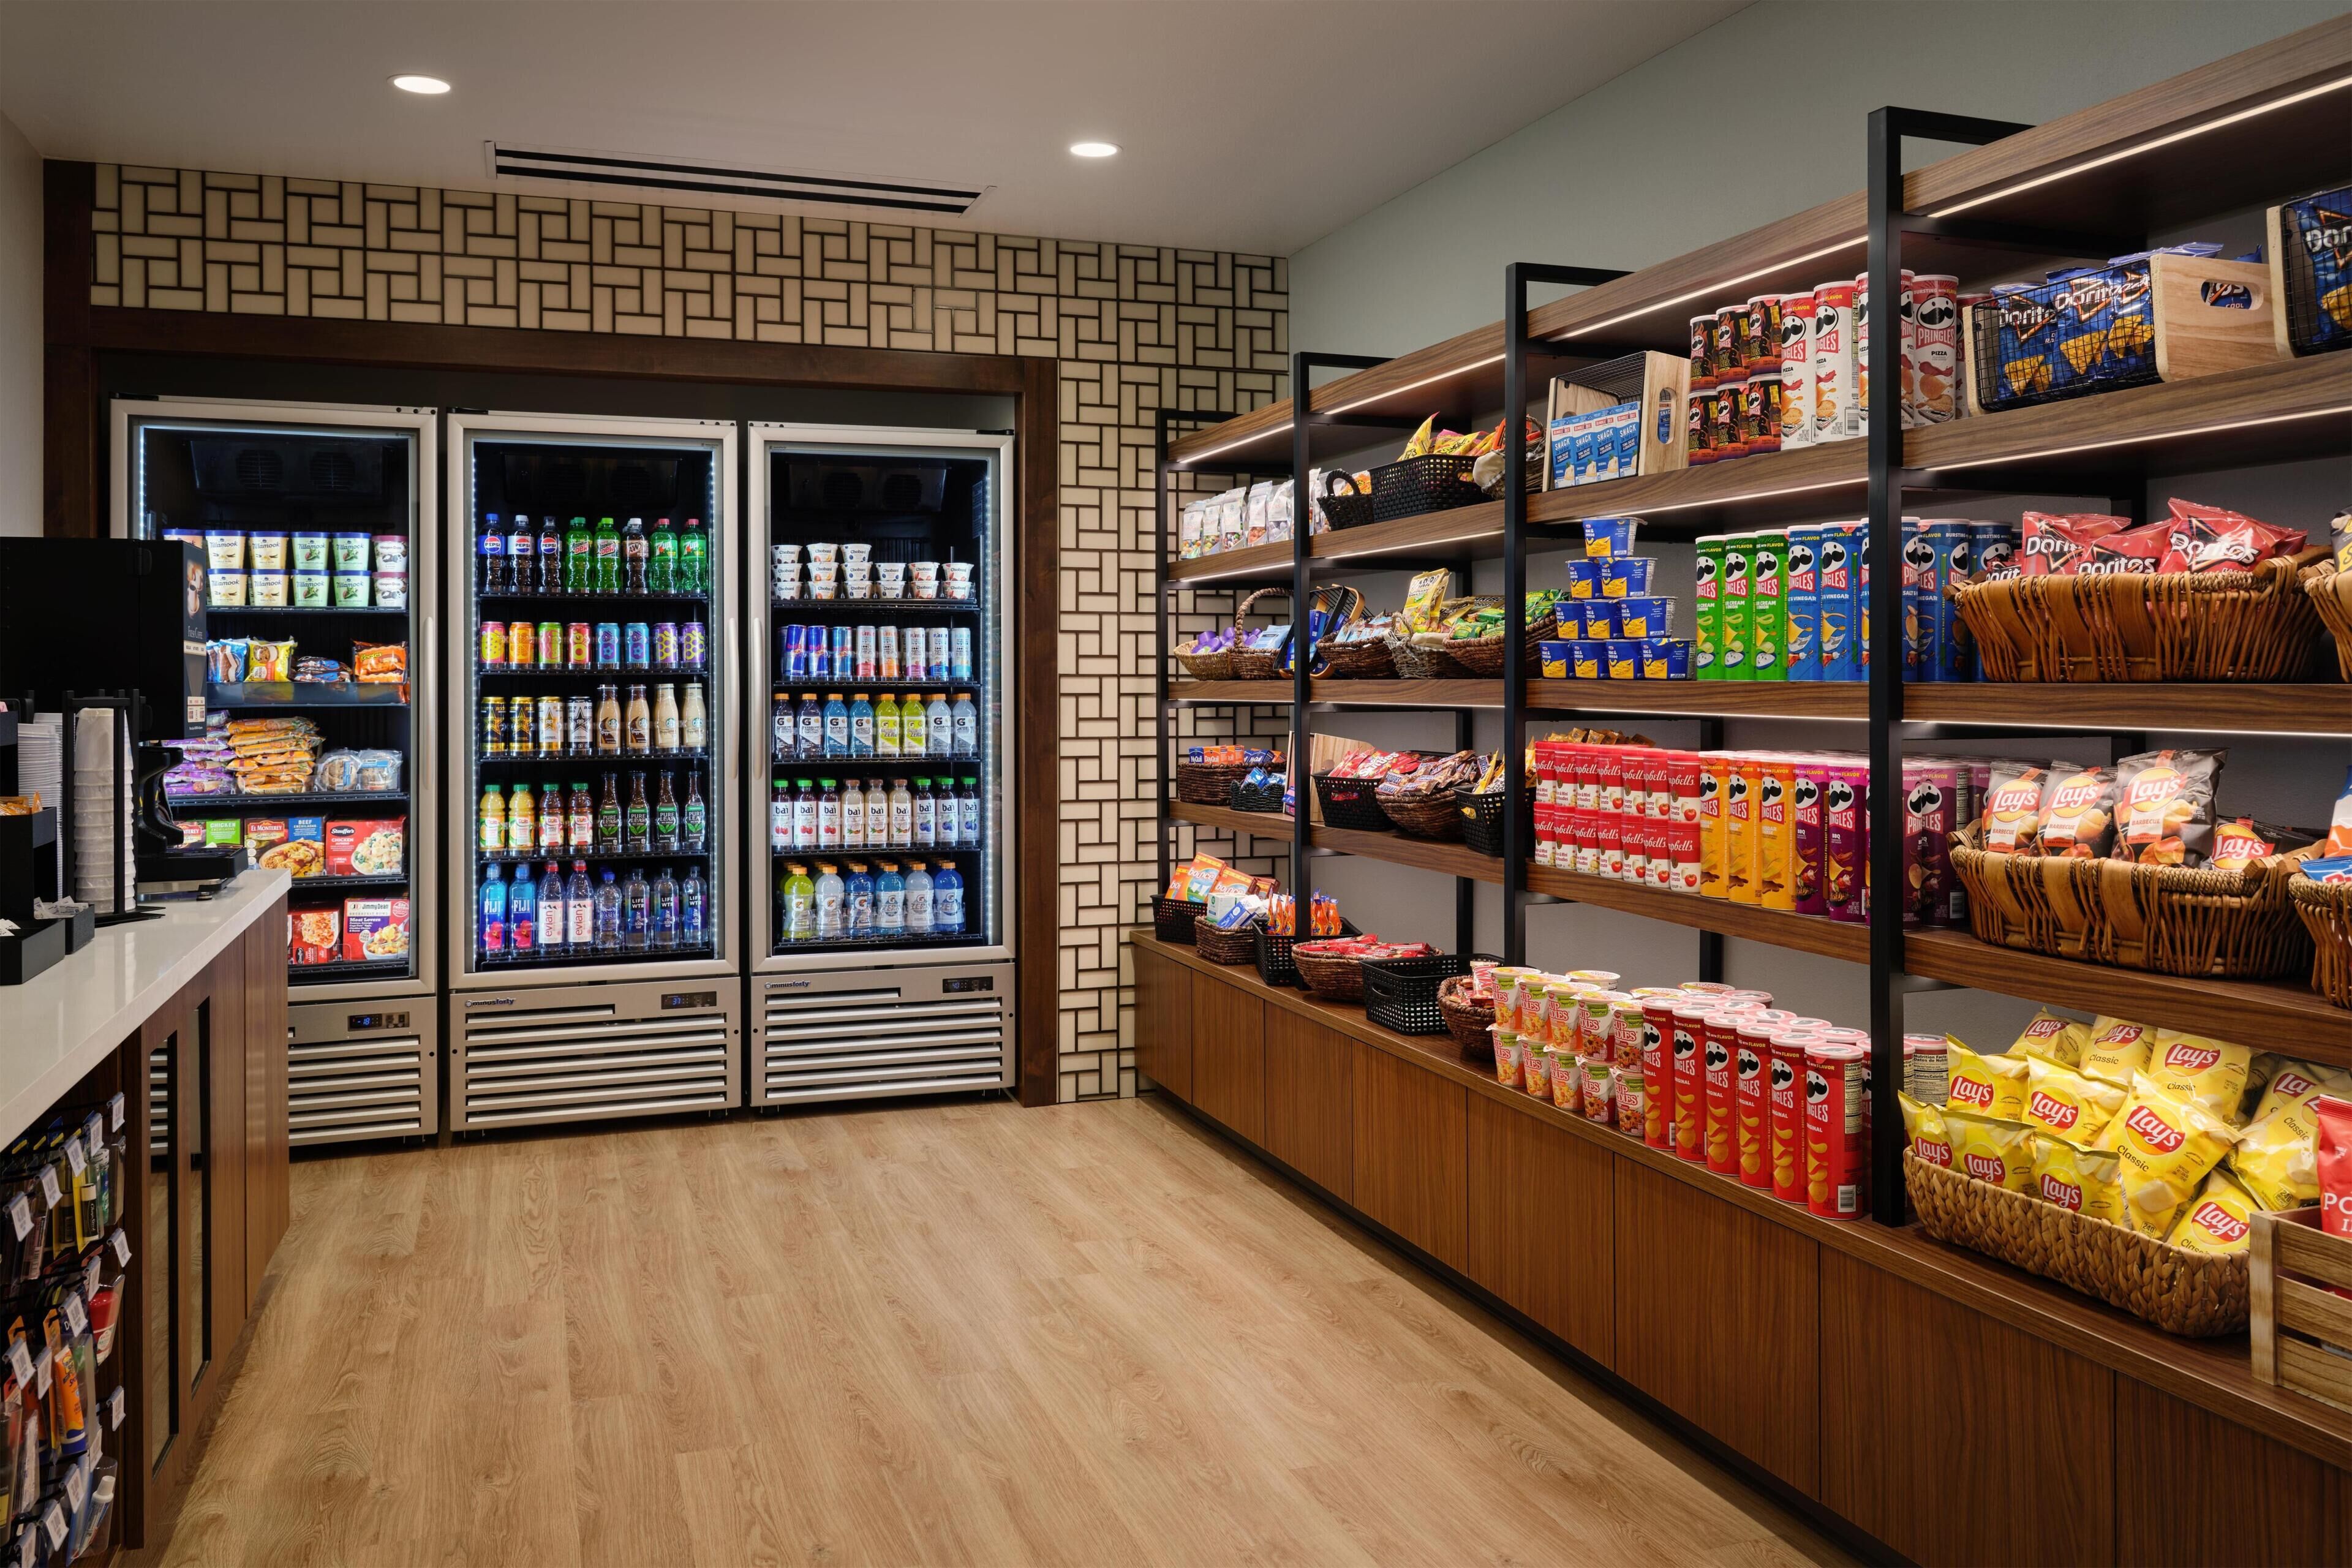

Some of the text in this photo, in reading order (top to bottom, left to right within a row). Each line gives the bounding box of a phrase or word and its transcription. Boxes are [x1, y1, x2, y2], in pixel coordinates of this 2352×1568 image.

[1918, 328, 1954, 347] PRINGLES
[1597, 429, 1613, 441] SNACK
[1619, 424, 1636, 437] SNACK
[1555, 439, 1570, 450] SNACK
[1576, 434, 1591, 447] SNACK
[2026, 538, 2082, 556] Dorit
[2172, 532, 2259, 564] Doritos
[2051, 784, 2099, 809] Lay's
[2130, 777, 2181, 804] Lay's
[775, 804, 788, 814] bai
[801, 804, 813, 813] bai
[824, 805, 836, 814] bai
[919, 803, 932, 812] bai
[965, 803, 977, 812] bai
[1992, 789, 2038, 813] Lay's
[871, 806, 883, 815] bai
[896, 806, 909, 815] bai
[2214, 837, 2266, 861] Lay's
[1188, 869, 1216, 880] bounce
[484, 900, 501, 913] FIJI
[513, 900, 530, 912] FIJI
[2089, 1054, 2119, 1065] Classic
[2166, 1044, 2218, 1069] Lay's
[1952, 1077, 1992, 1105] Lay's
[2167, 1082, 2196, 1092] Classic
[2032, 1093, 2078, 1125] Lay's
[2128, 1106, 2184, 1148] Lay's
[2283, 1117, 2310, 1142] Classic
[1918, 1138, 1950, 1164] Lay's
[2116, 1145, 2149, 1173] Classic
[1967, 1154, 2003, 1182] Lay's
[2043, 1175, 2079, 1208] Lay's
[2195, 1204, 2247, 1236] Lay's
